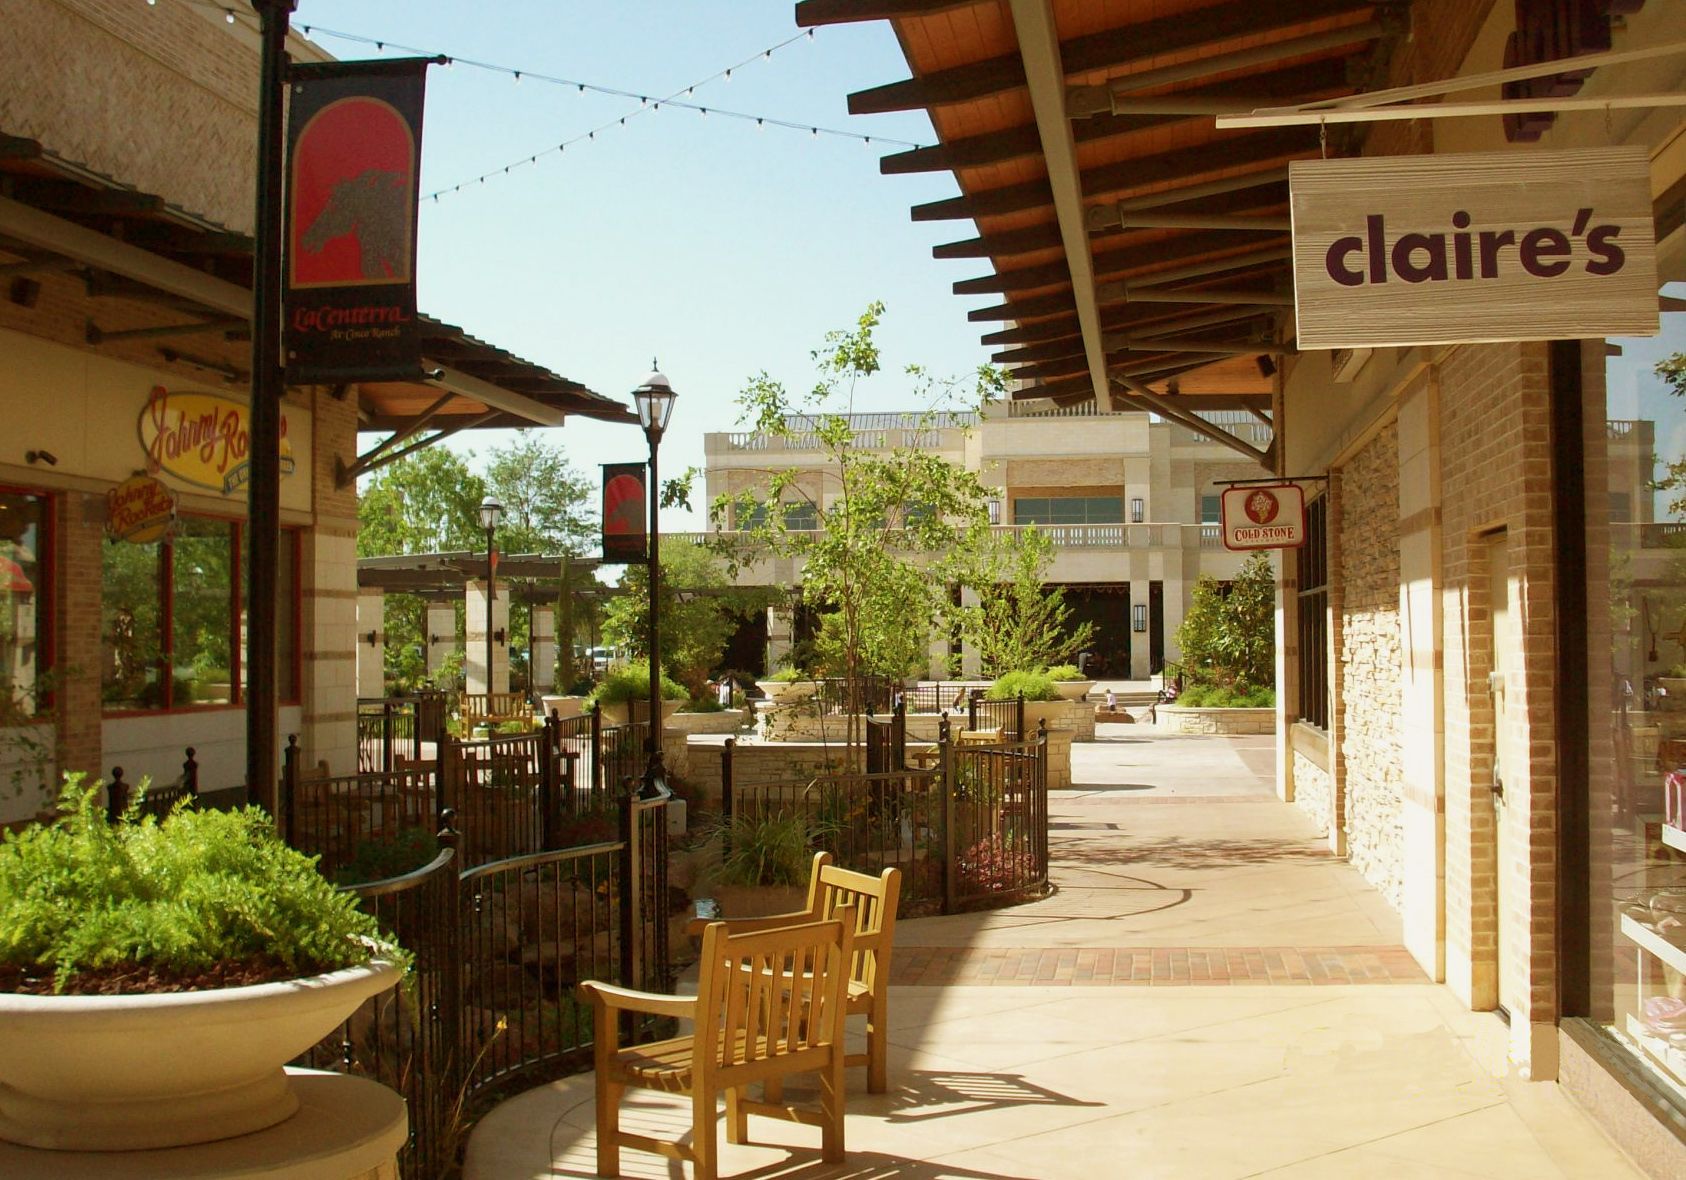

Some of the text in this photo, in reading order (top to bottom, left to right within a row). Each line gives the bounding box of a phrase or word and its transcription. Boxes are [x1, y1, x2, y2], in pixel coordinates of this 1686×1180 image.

[1326, 208, 1625, 286] claire's
[147, 385, 219, 473] Johnny
[1235, 529, 1260, 541] COLD
[1262, 527, 1294, 539] STONE
